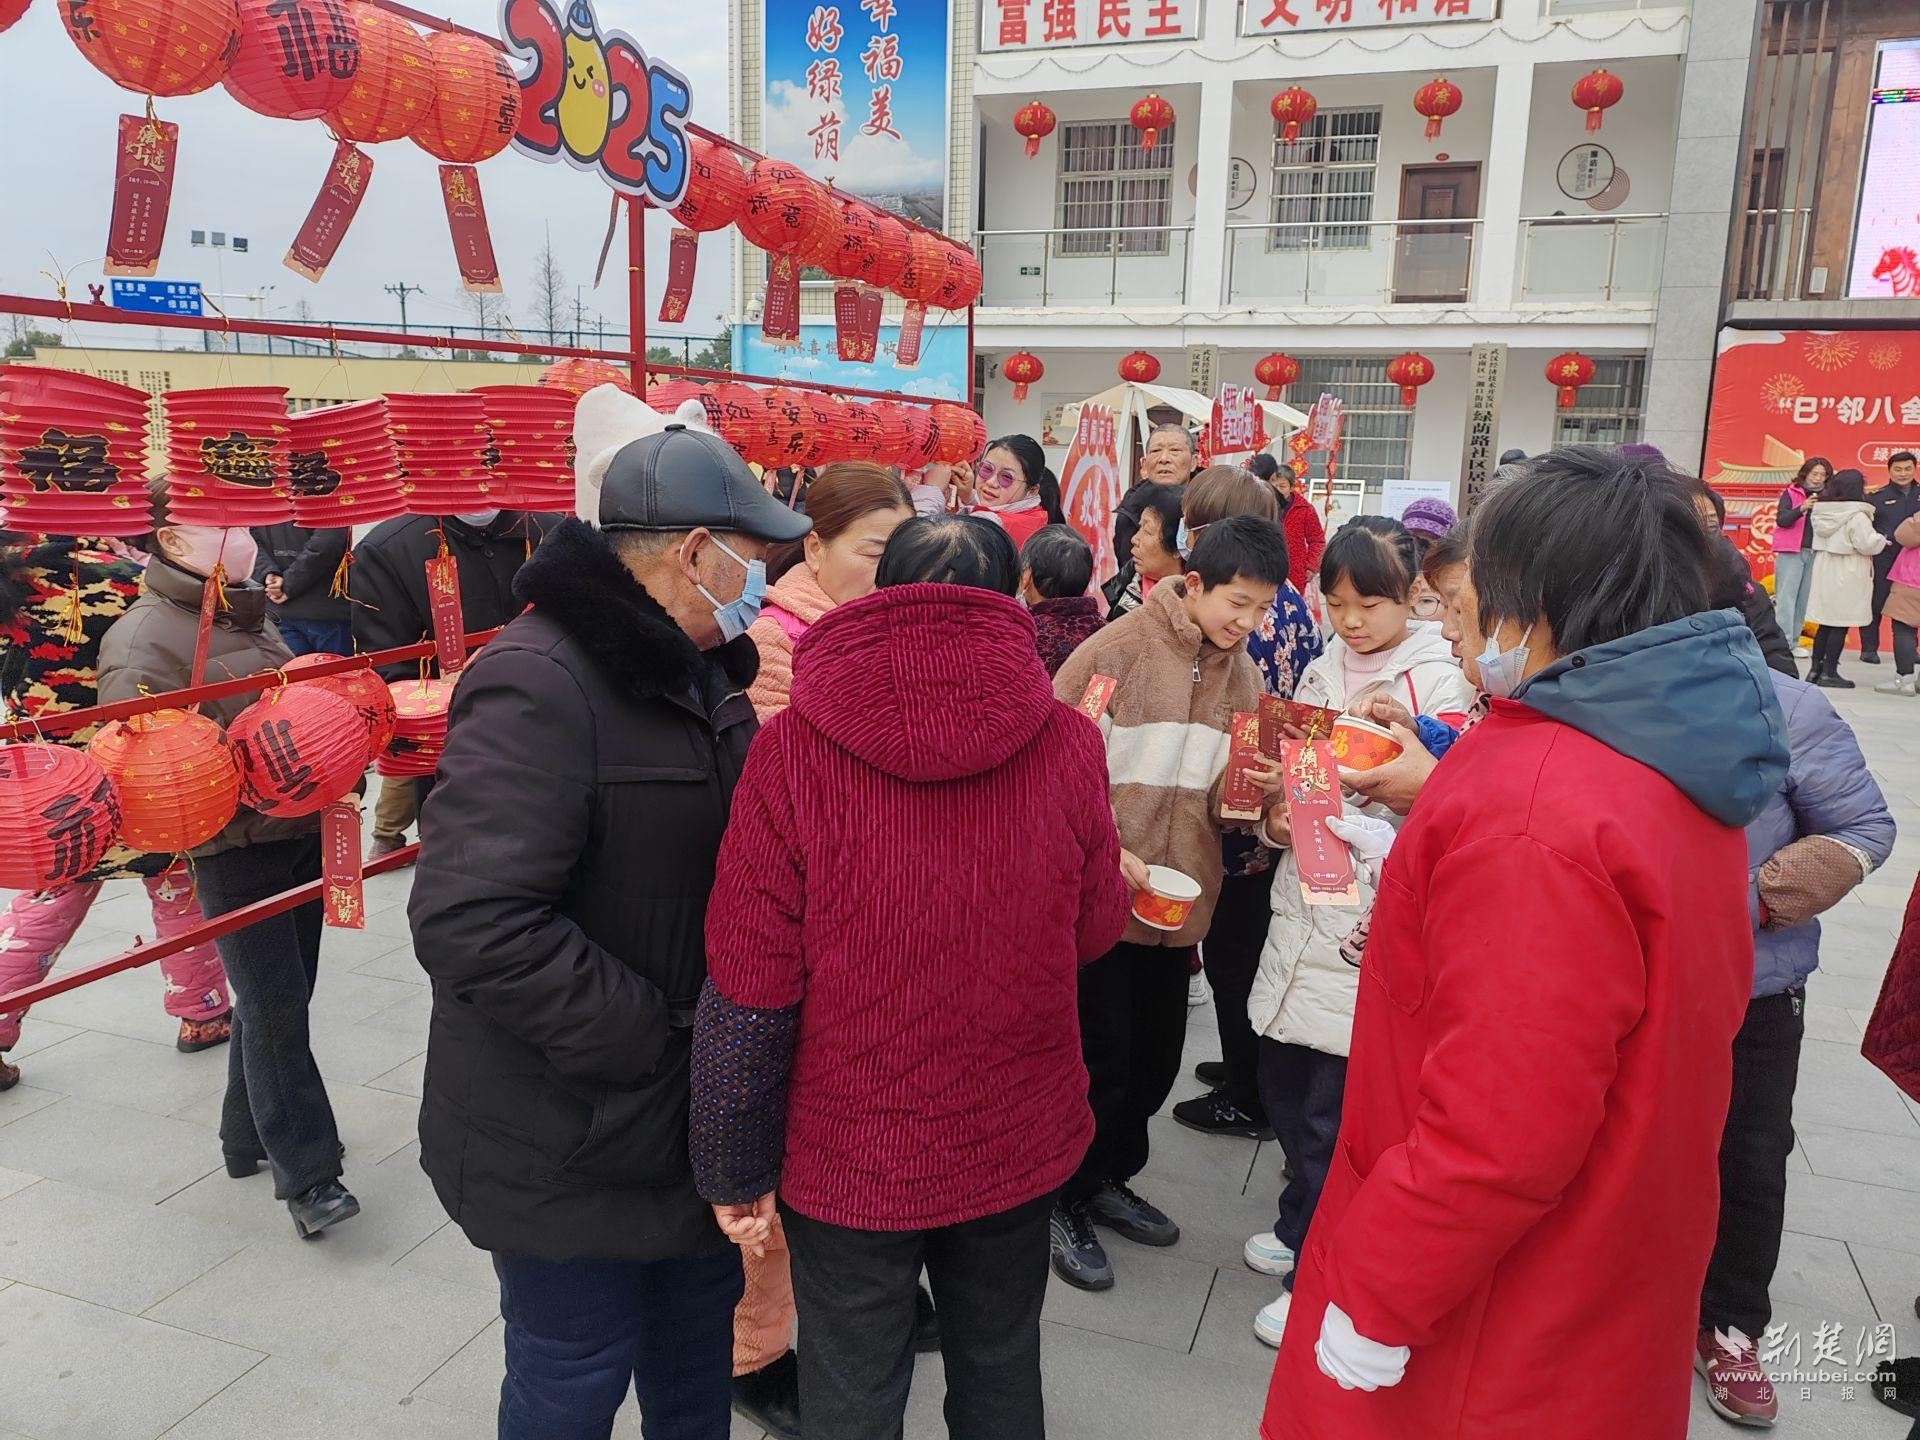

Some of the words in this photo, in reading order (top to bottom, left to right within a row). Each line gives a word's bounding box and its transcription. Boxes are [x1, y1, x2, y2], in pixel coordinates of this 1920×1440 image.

[806, 5, 845, 162] 好绿荫
[1561, 360, 1580, 378] 欢
[1466, 410, 1494, 516] 绿荫路社区居民委
[1289, 746, 1331, 791] 猜灯谜
